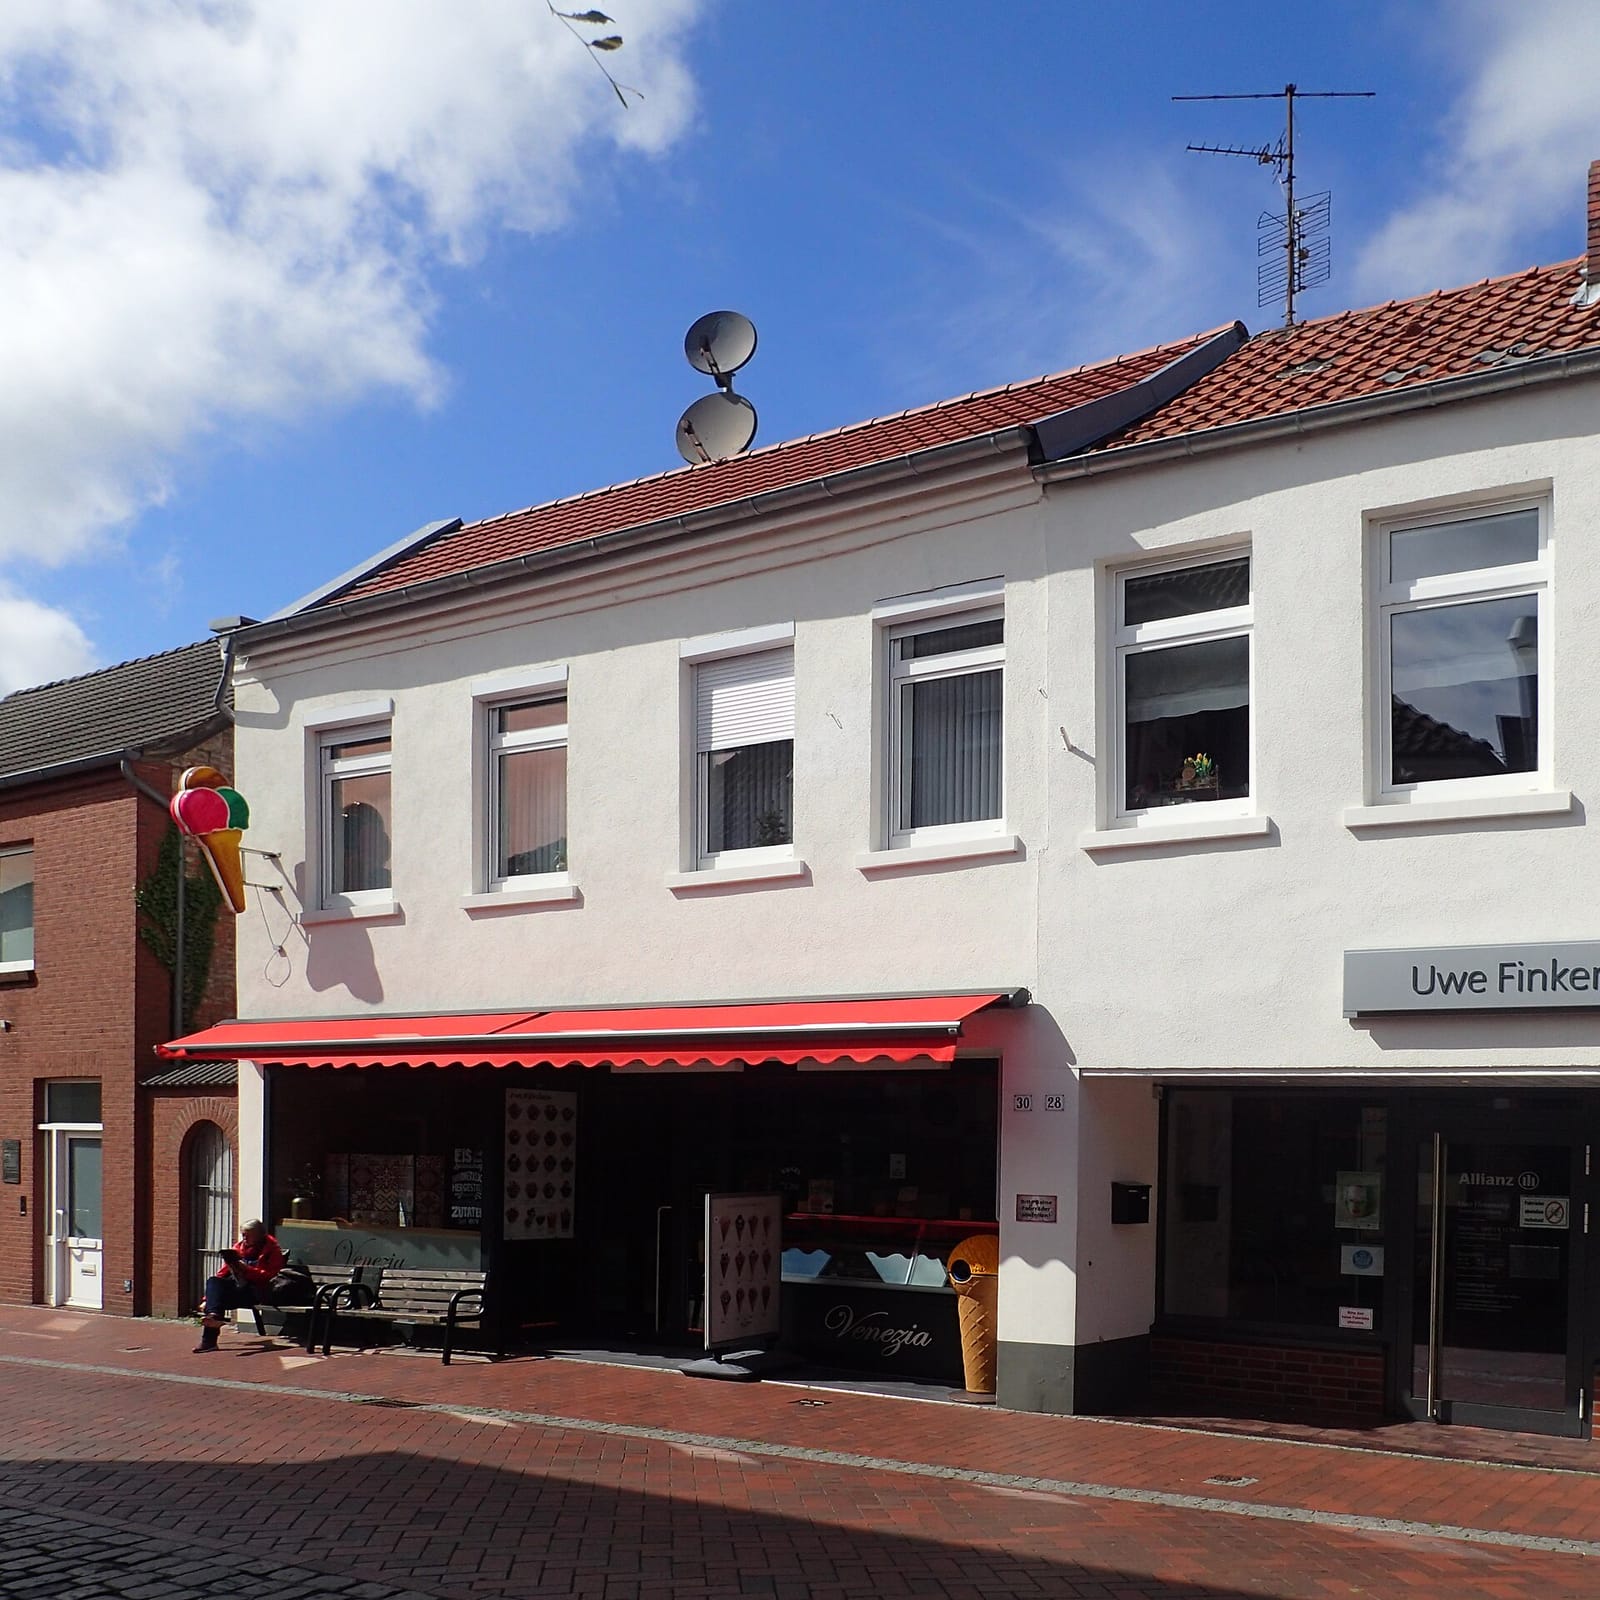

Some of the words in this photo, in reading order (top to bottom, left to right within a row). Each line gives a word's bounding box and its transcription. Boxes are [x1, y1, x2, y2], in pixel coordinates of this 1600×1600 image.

[1412, 965, 1488, 995] Uwe
[1016, 1096, 1030, 1109] 30
[1047, 1096, 1062, 1109] 28
[454, 1148, 473, 1163] EIS
[1458, 1172, 1515, 1187] Allianz
[824, 1304, 934, 1357] Venezia
